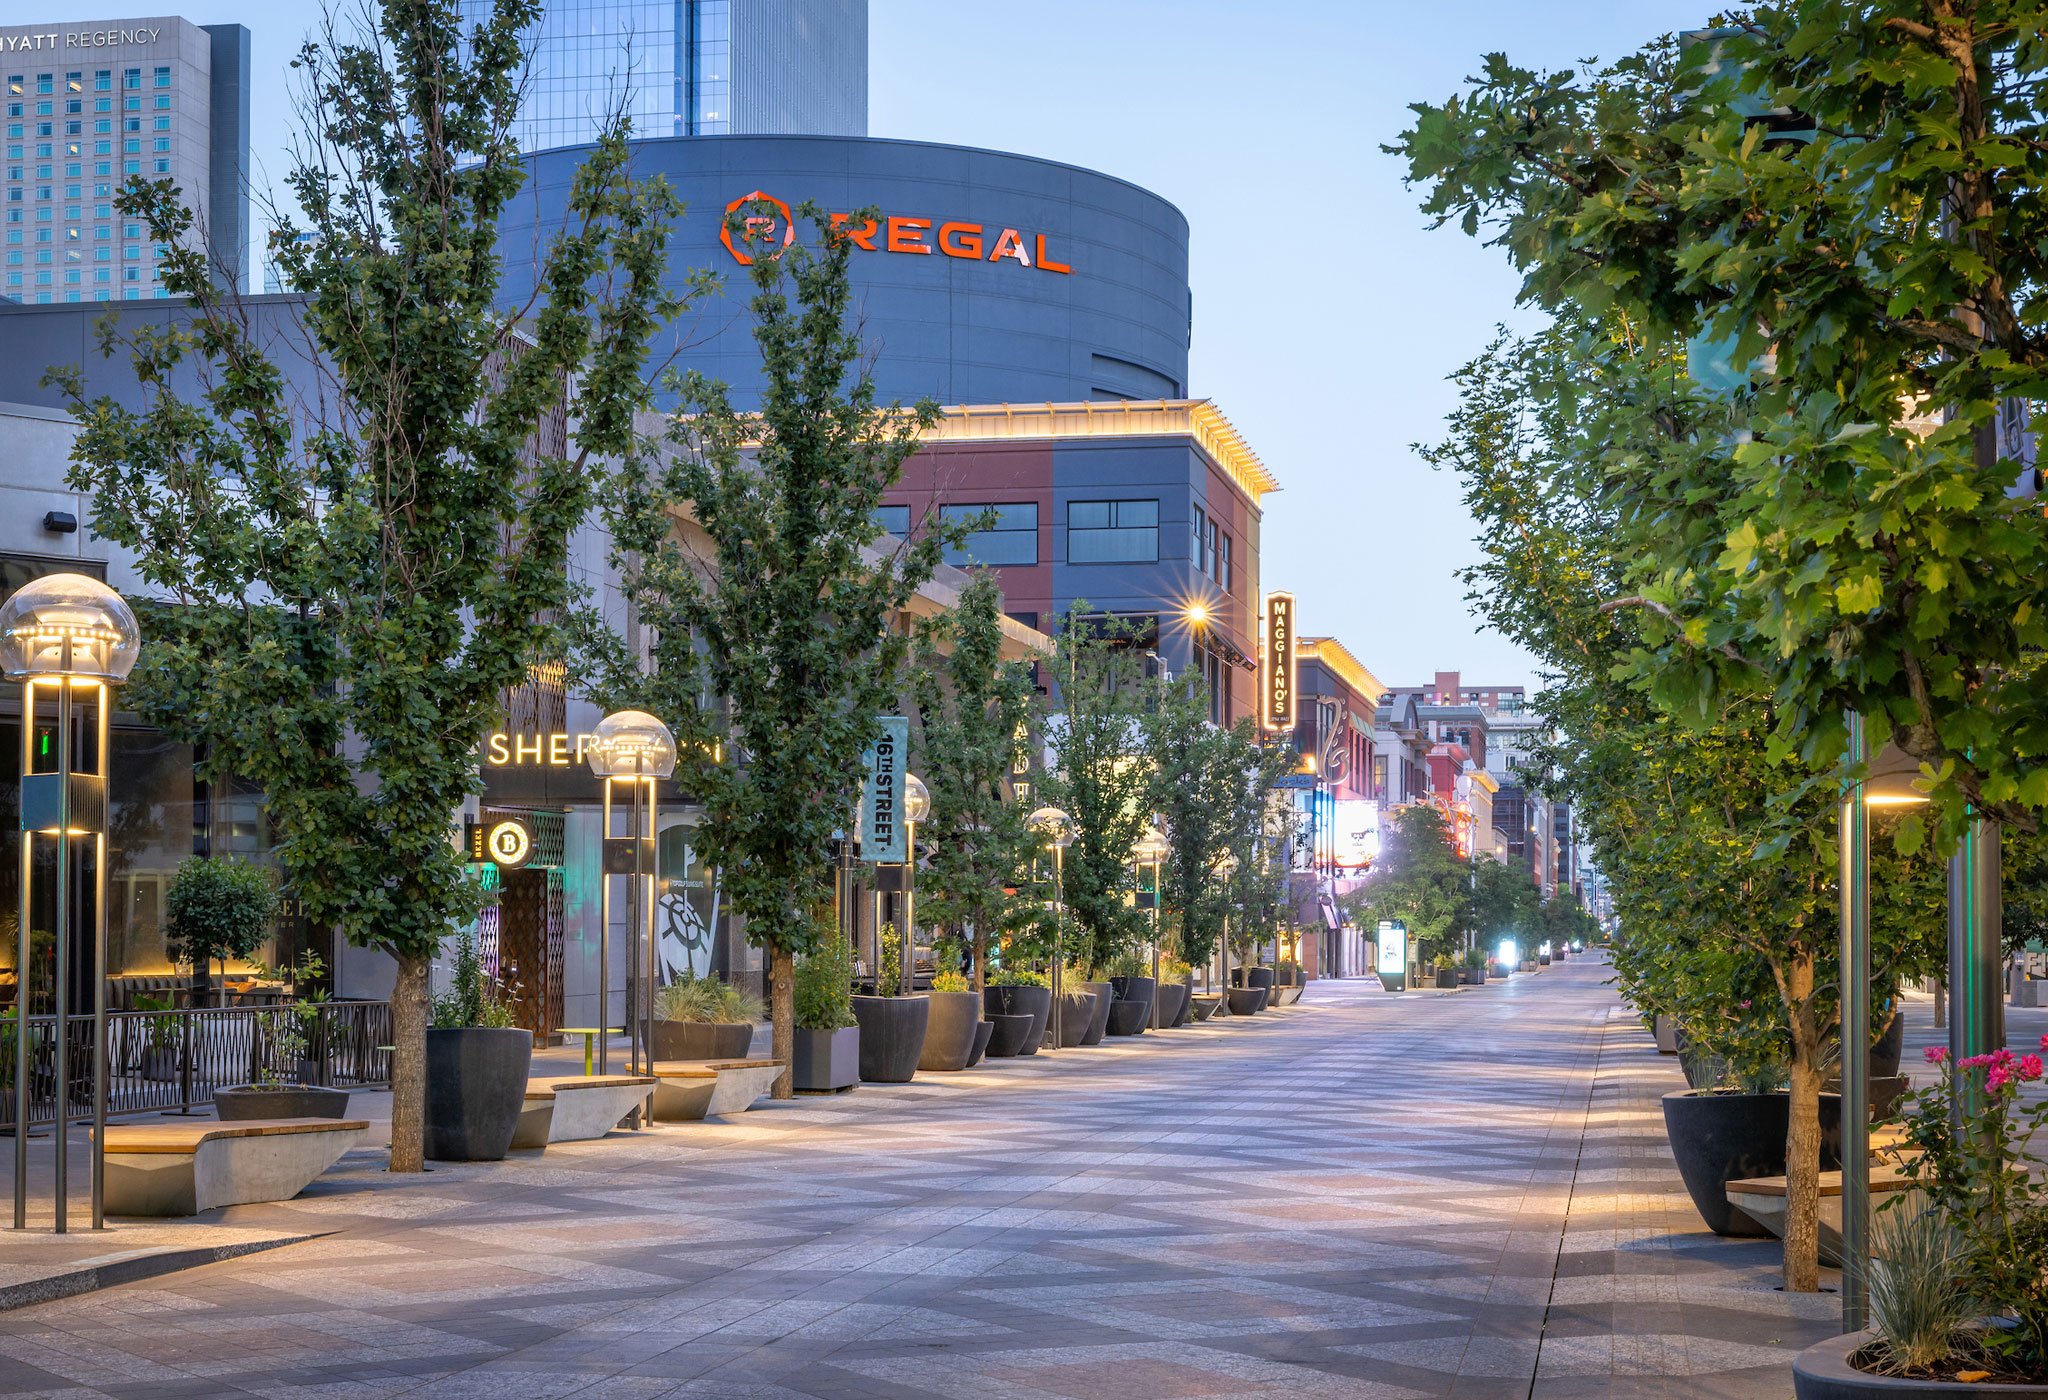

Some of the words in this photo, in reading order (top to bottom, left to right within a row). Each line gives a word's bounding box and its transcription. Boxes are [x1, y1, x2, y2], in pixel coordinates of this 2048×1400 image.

[66, 28, 161, 48] REGENCY
[829, 213, 1071, 274] REGAL
[1274, 602, 1288, 713] MAGGIANO'S
[877, 733, 894, 772] 16TH
[875, 774, 893, 846] STREET
[474, 828, 483, 858] BEZEL
[502, 834, 516, 852] B
